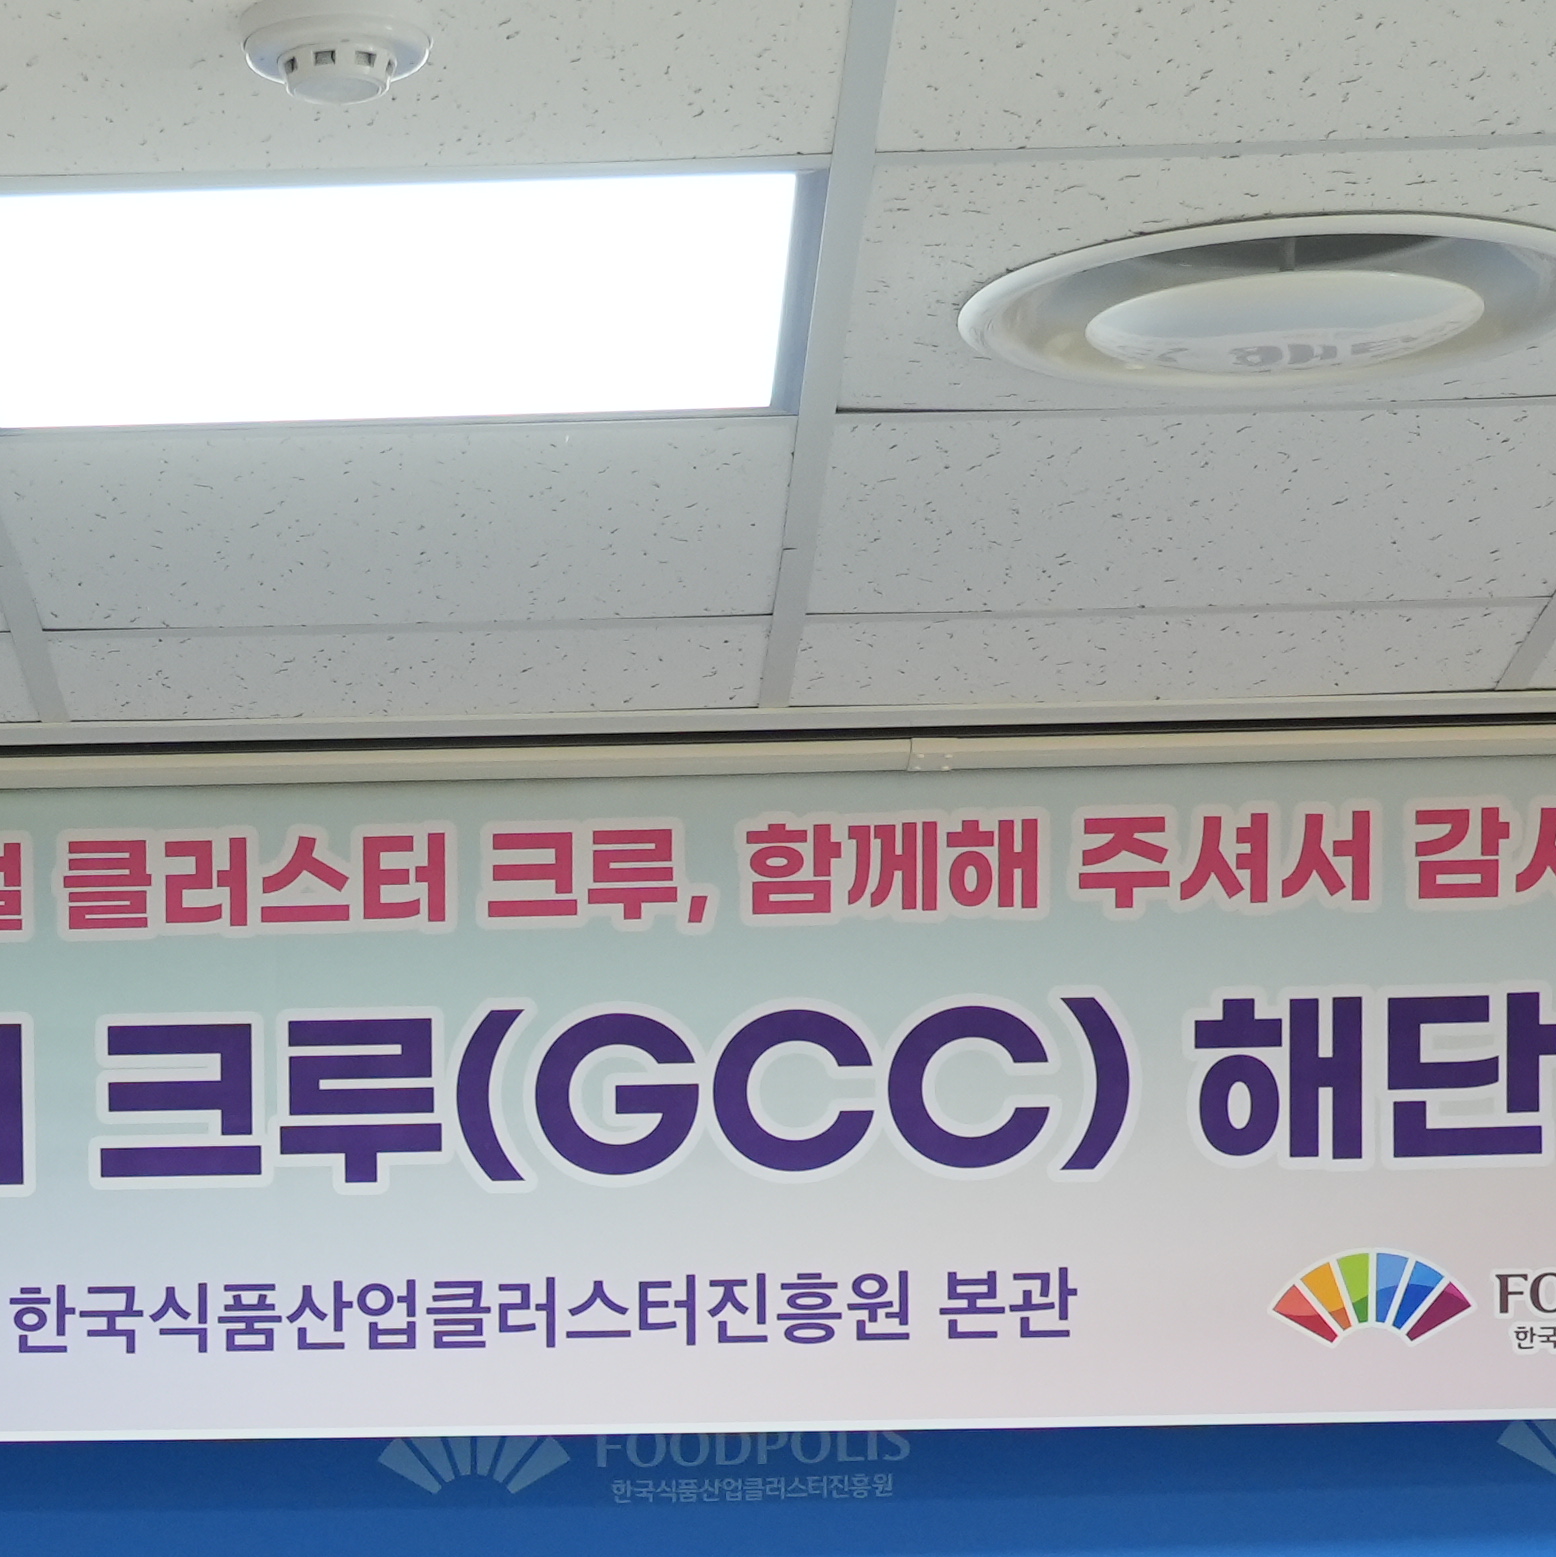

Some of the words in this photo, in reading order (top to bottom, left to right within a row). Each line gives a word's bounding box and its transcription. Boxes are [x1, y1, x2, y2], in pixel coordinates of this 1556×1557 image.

[63, 833, 445, 929] 클러스터
[488, 829, 708, 923] 크루,
[746, 819, 1038, 914] 함께해
[1079, 811, 1370, 908] 주셔서
[101, 997, 1129, 1183] 크루(GCC)
[10, 1271, 910, 1353] 한국식품산업클러스터진흥원
[939, 1267, 1077, 1339] 본관
[596, 1430, 911, 1467] FOODPOLIS
[612, 1474, 892, 1503] 한국식품산업클러스터진흥원
